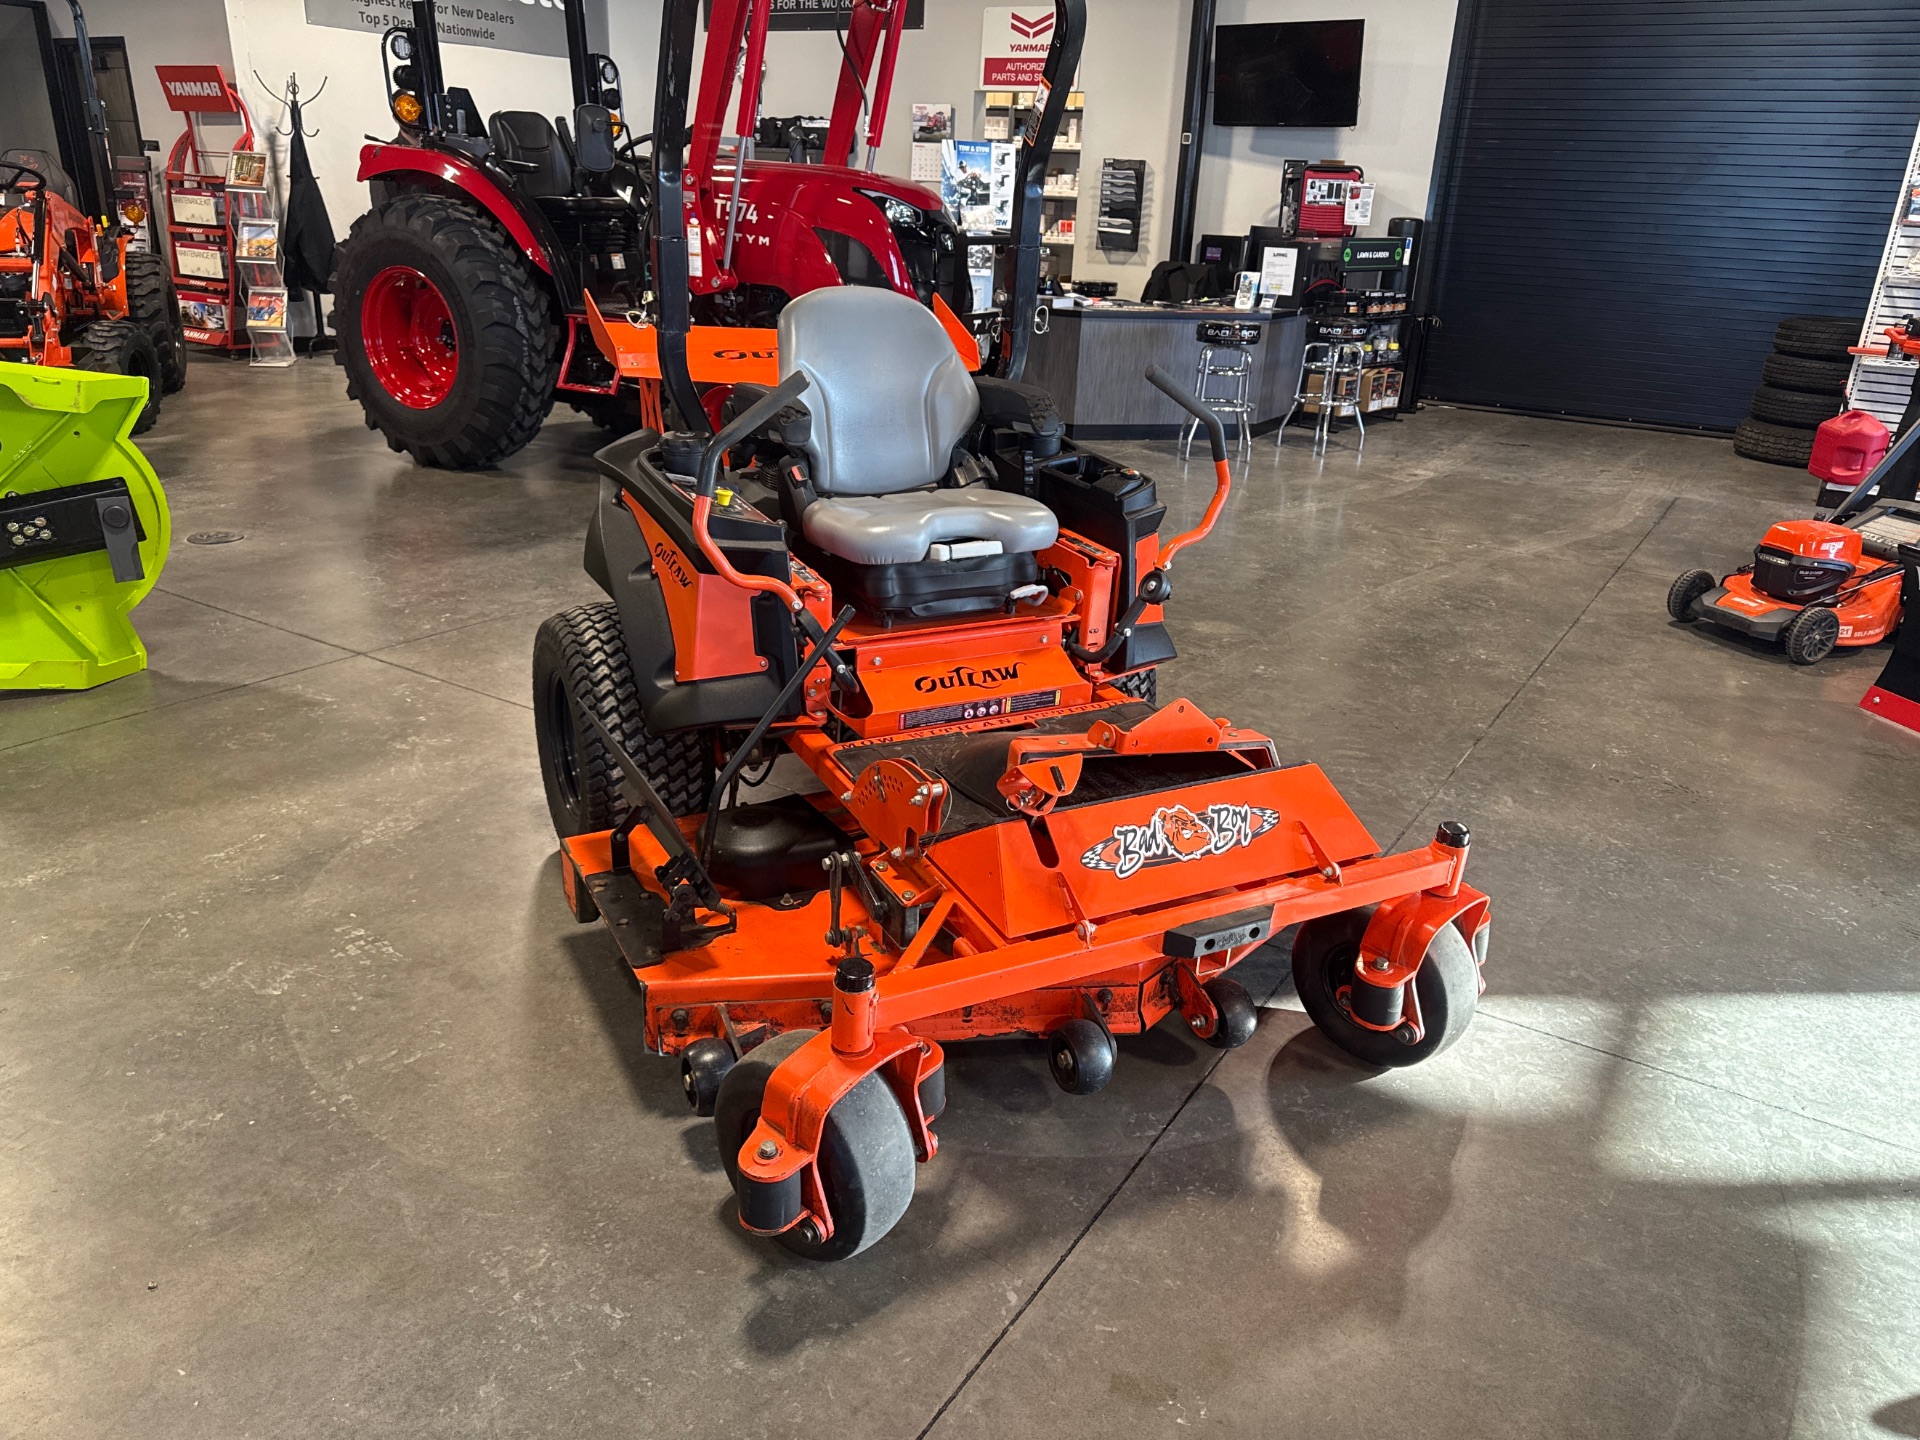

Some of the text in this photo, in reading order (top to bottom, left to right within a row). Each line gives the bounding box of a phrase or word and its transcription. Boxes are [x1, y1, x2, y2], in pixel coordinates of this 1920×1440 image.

[452, 5, 475, 19] New
[476, 9, 515, 25] Dealers
[358, 11, 381, 28] Top
[383, 14, 390, 26] 5
[437, 22, 496, 41] Nationwide
[992, 73, 1016, 81] PARTS
[1017, 73, 1033, 82] AND
[165, 81, 222, 97] YANMAR
[734, 232, 771, 247] TYM
[1356, 251, 1368, 259] LAWN
[1372, 251, 1390, 259] GARDEN
[841, 735, 896, 750] MOW
[907, 723, 973, 741] WITH
[982, 718, 1013, 728] AN
[1023, 697, 1132, 721] ATTITUDE
